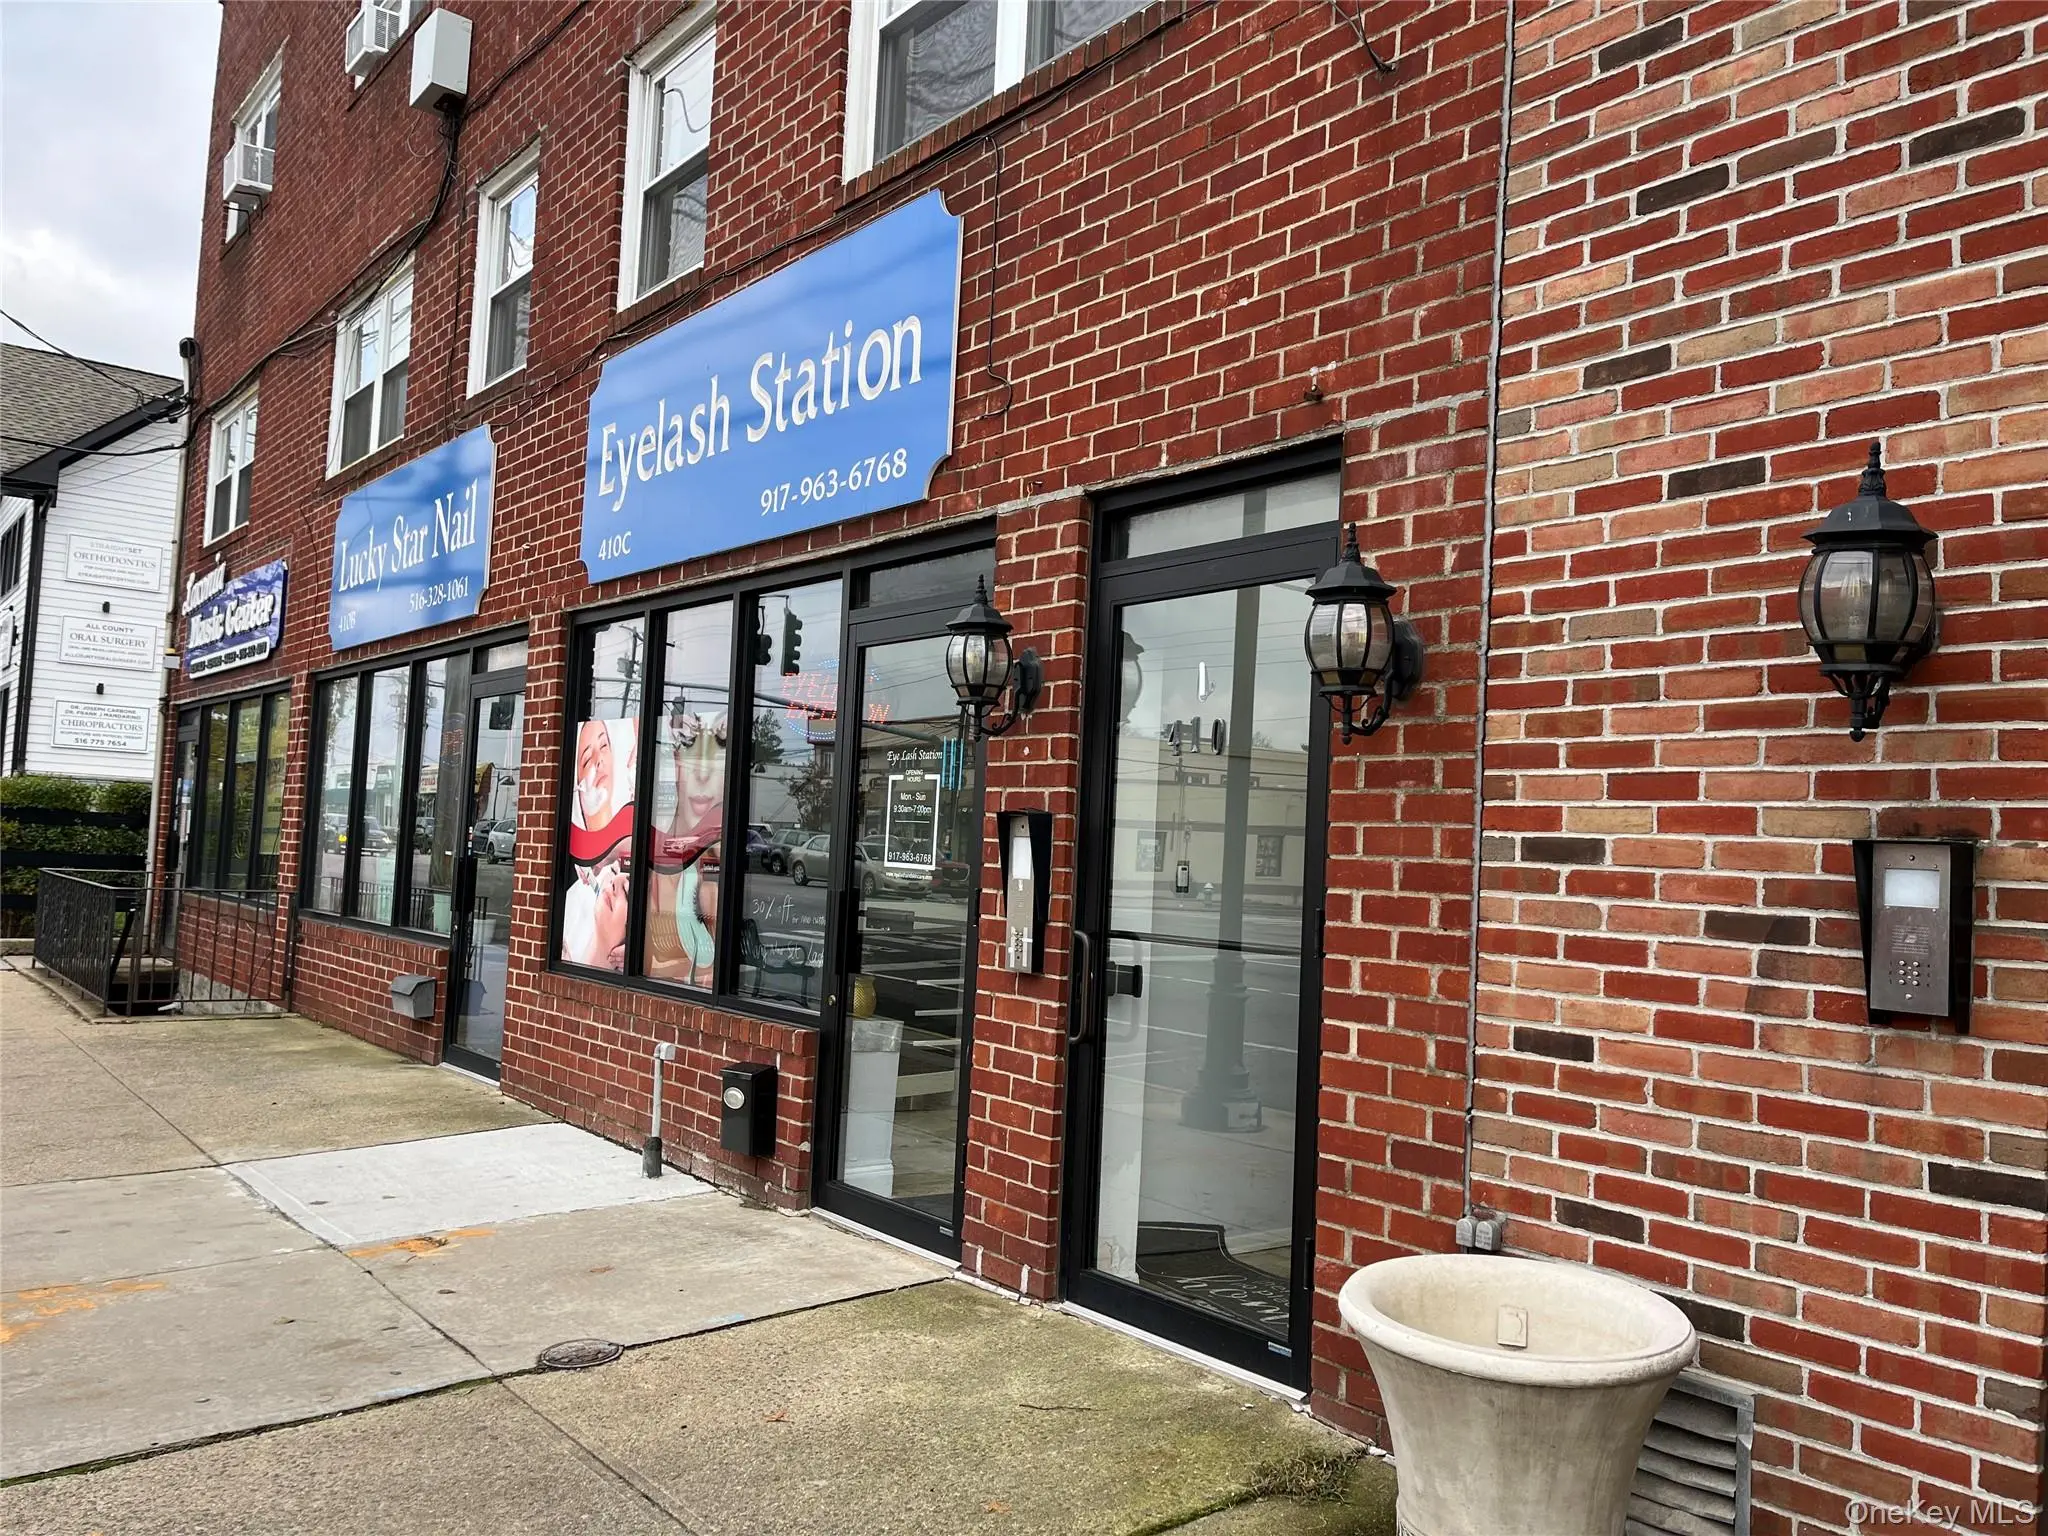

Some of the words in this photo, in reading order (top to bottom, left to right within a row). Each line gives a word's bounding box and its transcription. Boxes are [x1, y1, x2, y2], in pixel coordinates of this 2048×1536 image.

[598, 374, 730, 512] Eyelash
[746, 314, 922, 443] Station
[760, 447, 908, 517] 917-963-6768
[338, 526, 387, 592] Lucky
[391, 514, 428, 574] Star
[431, 478, 478, 559] Nail
[598, 531, 632, 561] 410C
[73, 551, 157, 568] ORTHODONTICS
[409, 576, 469, 613] 516-328-1061
[225, 593, 274, 636] Center
[69, 632, 99, 642] ORAL
[101, 635, 147, 648] SURGERY
[102, 625, 134, 633] COUNTY
[61, 719, 143, 731] CHIROPRACTORS
[1167, 715, 1226, 756] 410
[887, 750, 900, 766] Eye
[901, 747, 917, 760] Lash
[918, 749, 943, 760] Station
[915, 792, 926, 801] Sun
[888, 851, 932, 863] 917-963-6768
